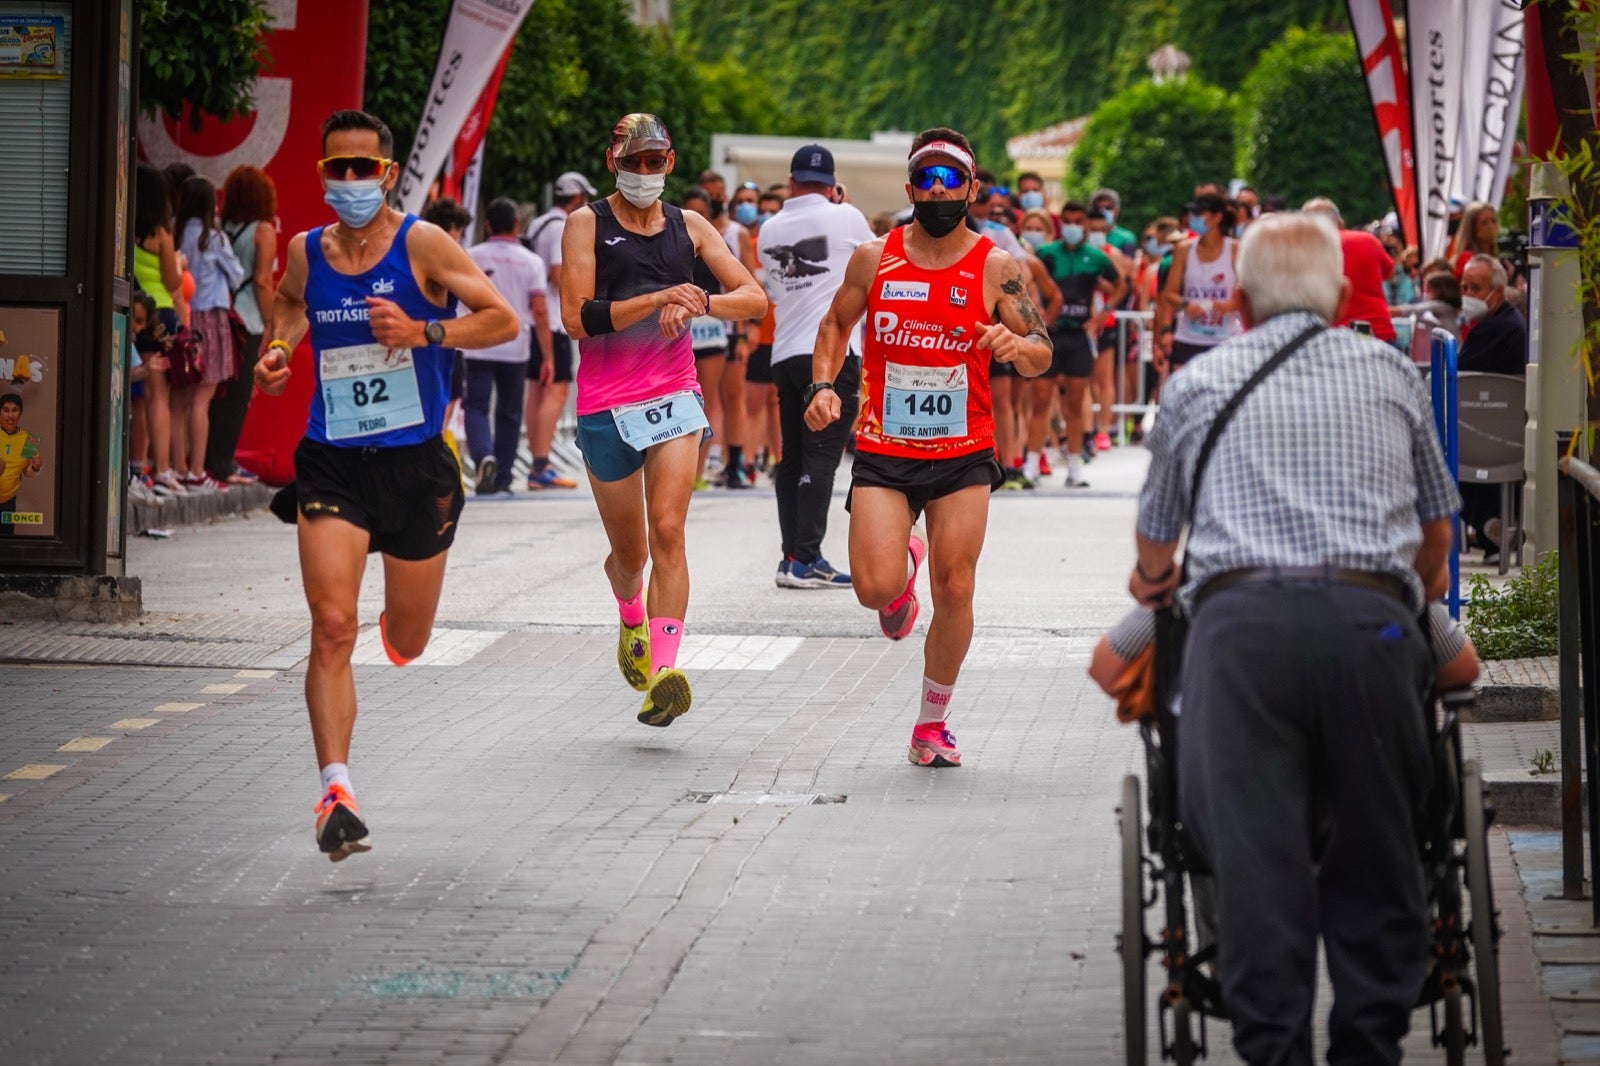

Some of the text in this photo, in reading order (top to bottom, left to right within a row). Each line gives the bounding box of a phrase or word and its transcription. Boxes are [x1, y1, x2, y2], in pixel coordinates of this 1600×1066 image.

[874, 311, 973, 353] Polisalud
[903, 320, 944, 332] Clínicas
[352, 378, 390, 407] 82
[645, 402, 673, 425] 67
[904, 394, 952, 416] 140
[358, 416, 387, 432] PEDRO
[899, 426, 949, 437] JOSE ANTONIO
[651, 426, 683, 443] HIPOLITO
[13, 514, 41, 523] ONCE
